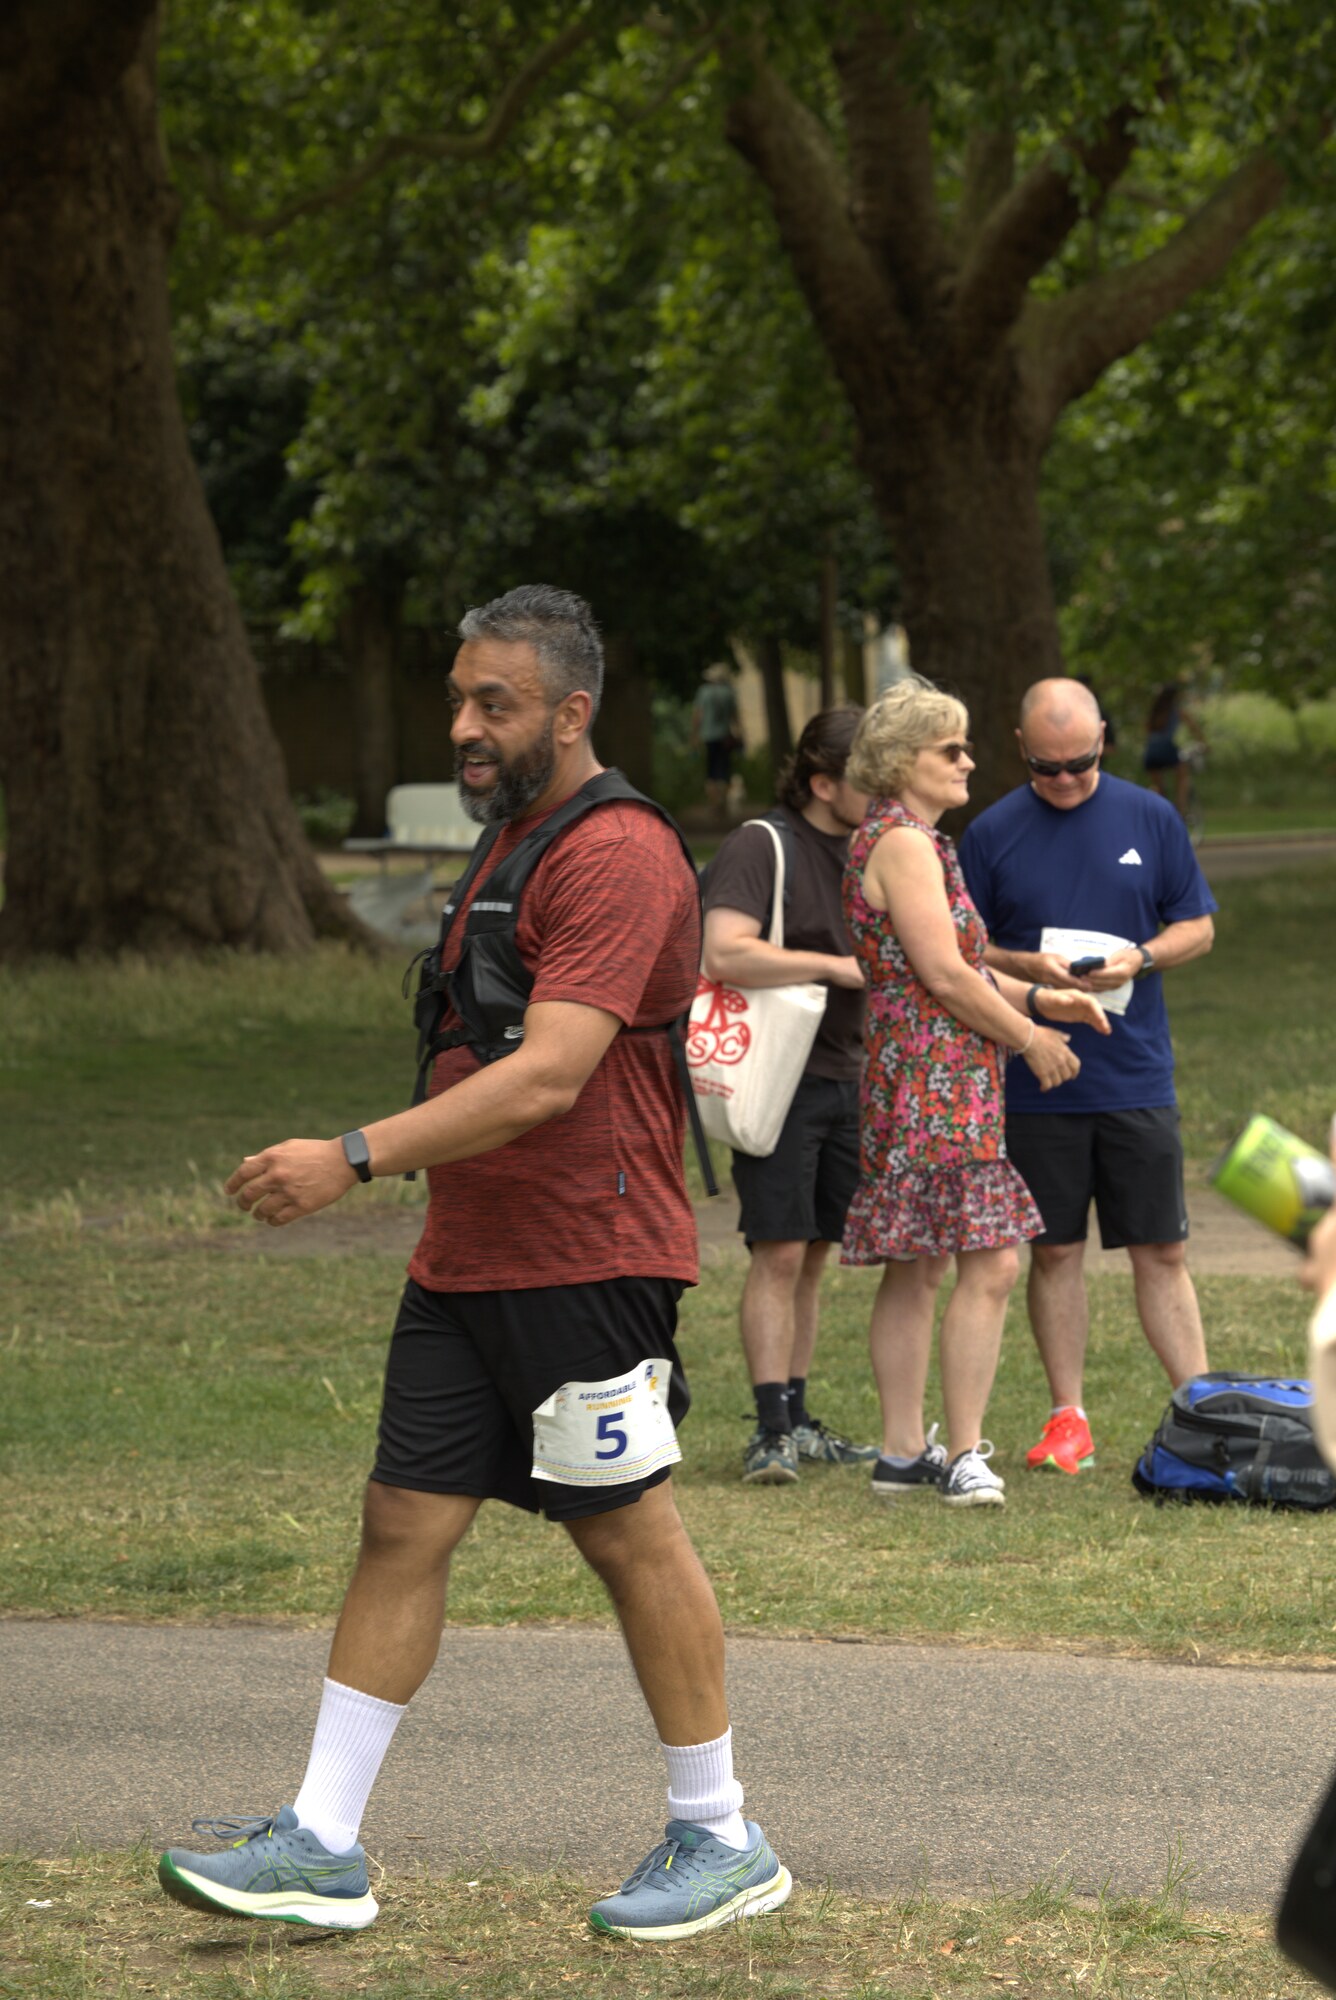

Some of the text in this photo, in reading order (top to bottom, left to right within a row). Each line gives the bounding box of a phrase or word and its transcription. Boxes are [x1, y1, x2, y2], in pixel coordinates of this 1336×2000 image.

[578, 1381, 637, 1401] AFFORDABLE
[586, 1395, 633, 1412] RUNNING
[595, 1411, 628, 1460] 5
